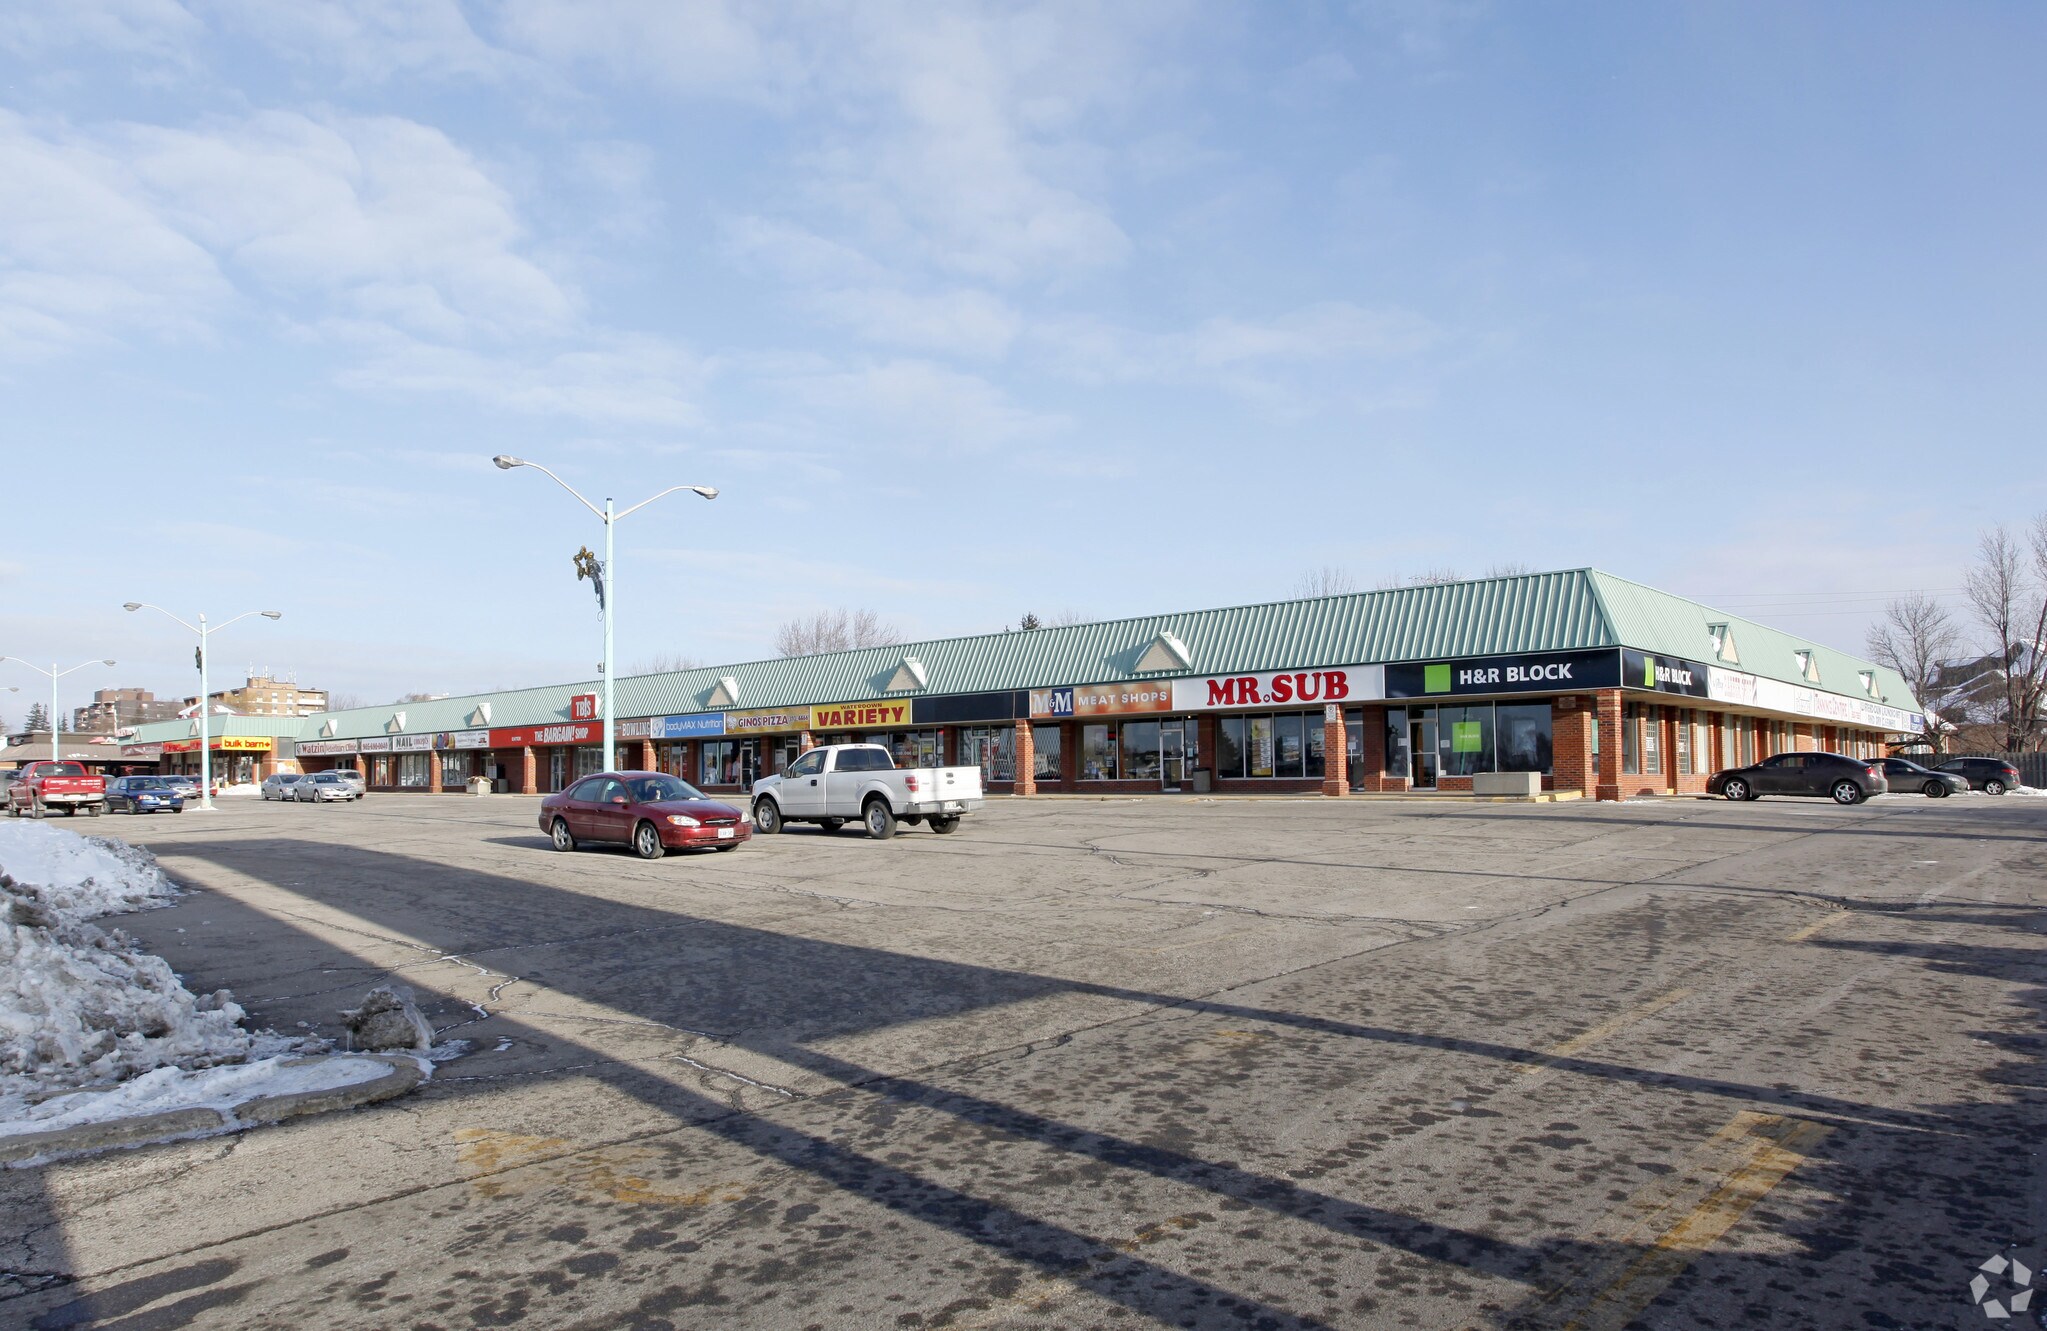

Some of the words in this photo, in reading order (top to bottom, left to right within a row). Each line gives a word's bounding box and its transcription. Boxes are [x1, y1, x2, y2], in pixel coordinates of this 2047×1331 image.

[1459, 668, 1500, 685] H&R
[1506, 663, 1573, 682] BLOCK
[1655, 665, 1671, 683] H&R
[1671, 668, 1692, 686] BLOCK
[1078, 694, 1116, 706] MEAT
[1121, 691, 1168, 703] SHOPS
[697, 718, 723, 729] Nutrition
[762, 714, 789, 726] PIZZA
[817, 706, 905, 727] VARIETY
[534, 730, 543, 742] THE
[543, 725, 576, 743] BARGAIN!
[575, 727, 589, 739] SHOP
[622, 721, 651, 737] BOWLING
[224, 739, 242, 748] bulk
[244, 739, 264, 748] barn
[396, 736, 413, 748] NAIL
